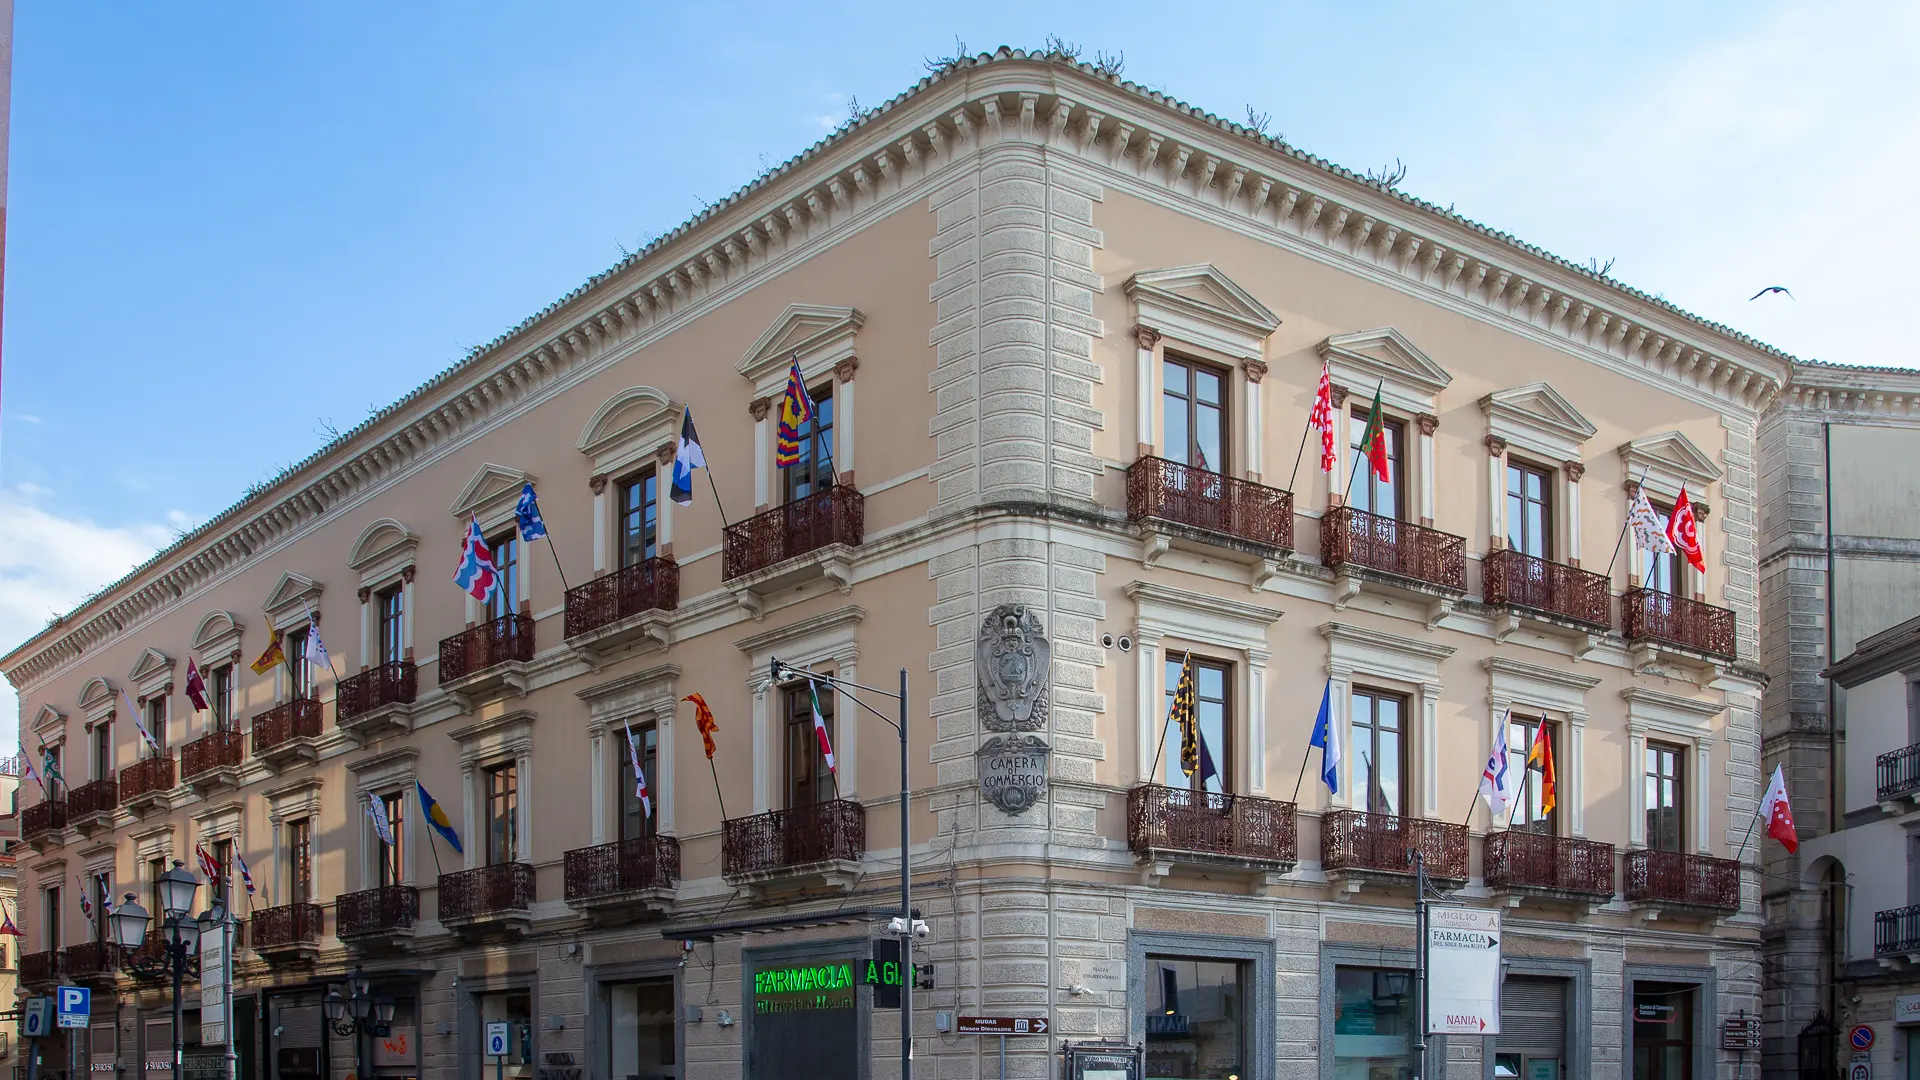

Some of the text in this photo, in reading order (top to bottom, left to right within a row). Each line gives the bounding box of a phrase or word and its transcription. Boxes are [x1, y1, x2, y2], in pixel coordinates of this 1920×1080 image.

[990, 757, 1037, 770] CAMERA
[984, 775, 1044, 787] COMMERCIO
[1437, 912, 1477, 921] MIGLIO
[1433, 931, 1486, 943] FARMACIA
[755, 964, 853, 994] FARMACIA
[64, 989, 83, 1012] P
[1446, 1014, 1477, 1025] NANIA
